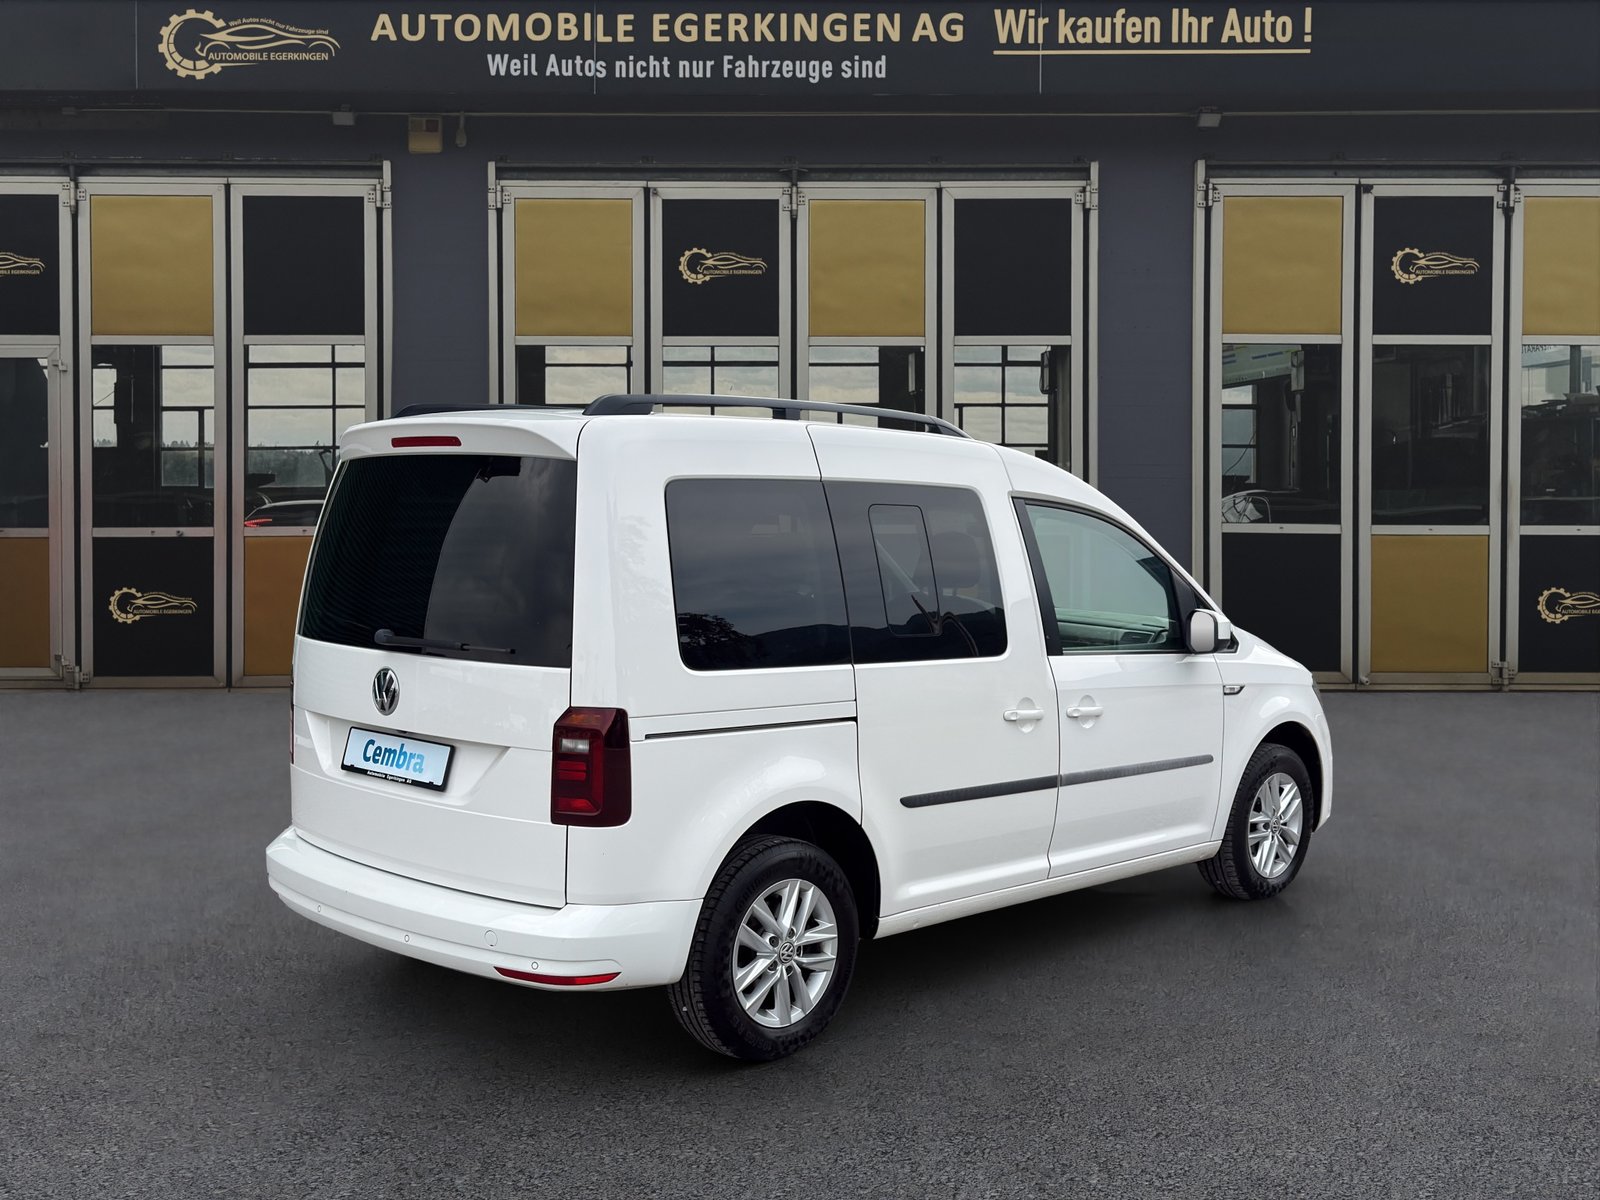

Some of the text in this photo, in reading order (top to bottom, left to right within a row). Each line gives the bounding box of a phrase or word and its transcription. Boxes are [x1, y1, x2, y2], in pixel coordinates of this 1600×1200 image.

[229, 18, 242, 27] Weil
[260, 18, 275, 26] nicht
[286, 24, 316, 35] Fahrzeuge
[370, 12, 964, 43] AUTOMOBILE EGERKINGEN AG
[993, 8, 1050, 44] Wir
[1058, 8, 1161, 44] kaufen
[1171, 8, 1214, 44] Ihr
[1220, 7, 1293, 43] Auto
[207, 52, 329, 61] AUTOMOBILE EGERKINGEN
[486, 53, 887, 84] Weil Autos nicht nur Fahrzeuge sind
[362, 738, 425, 774] Cembra
